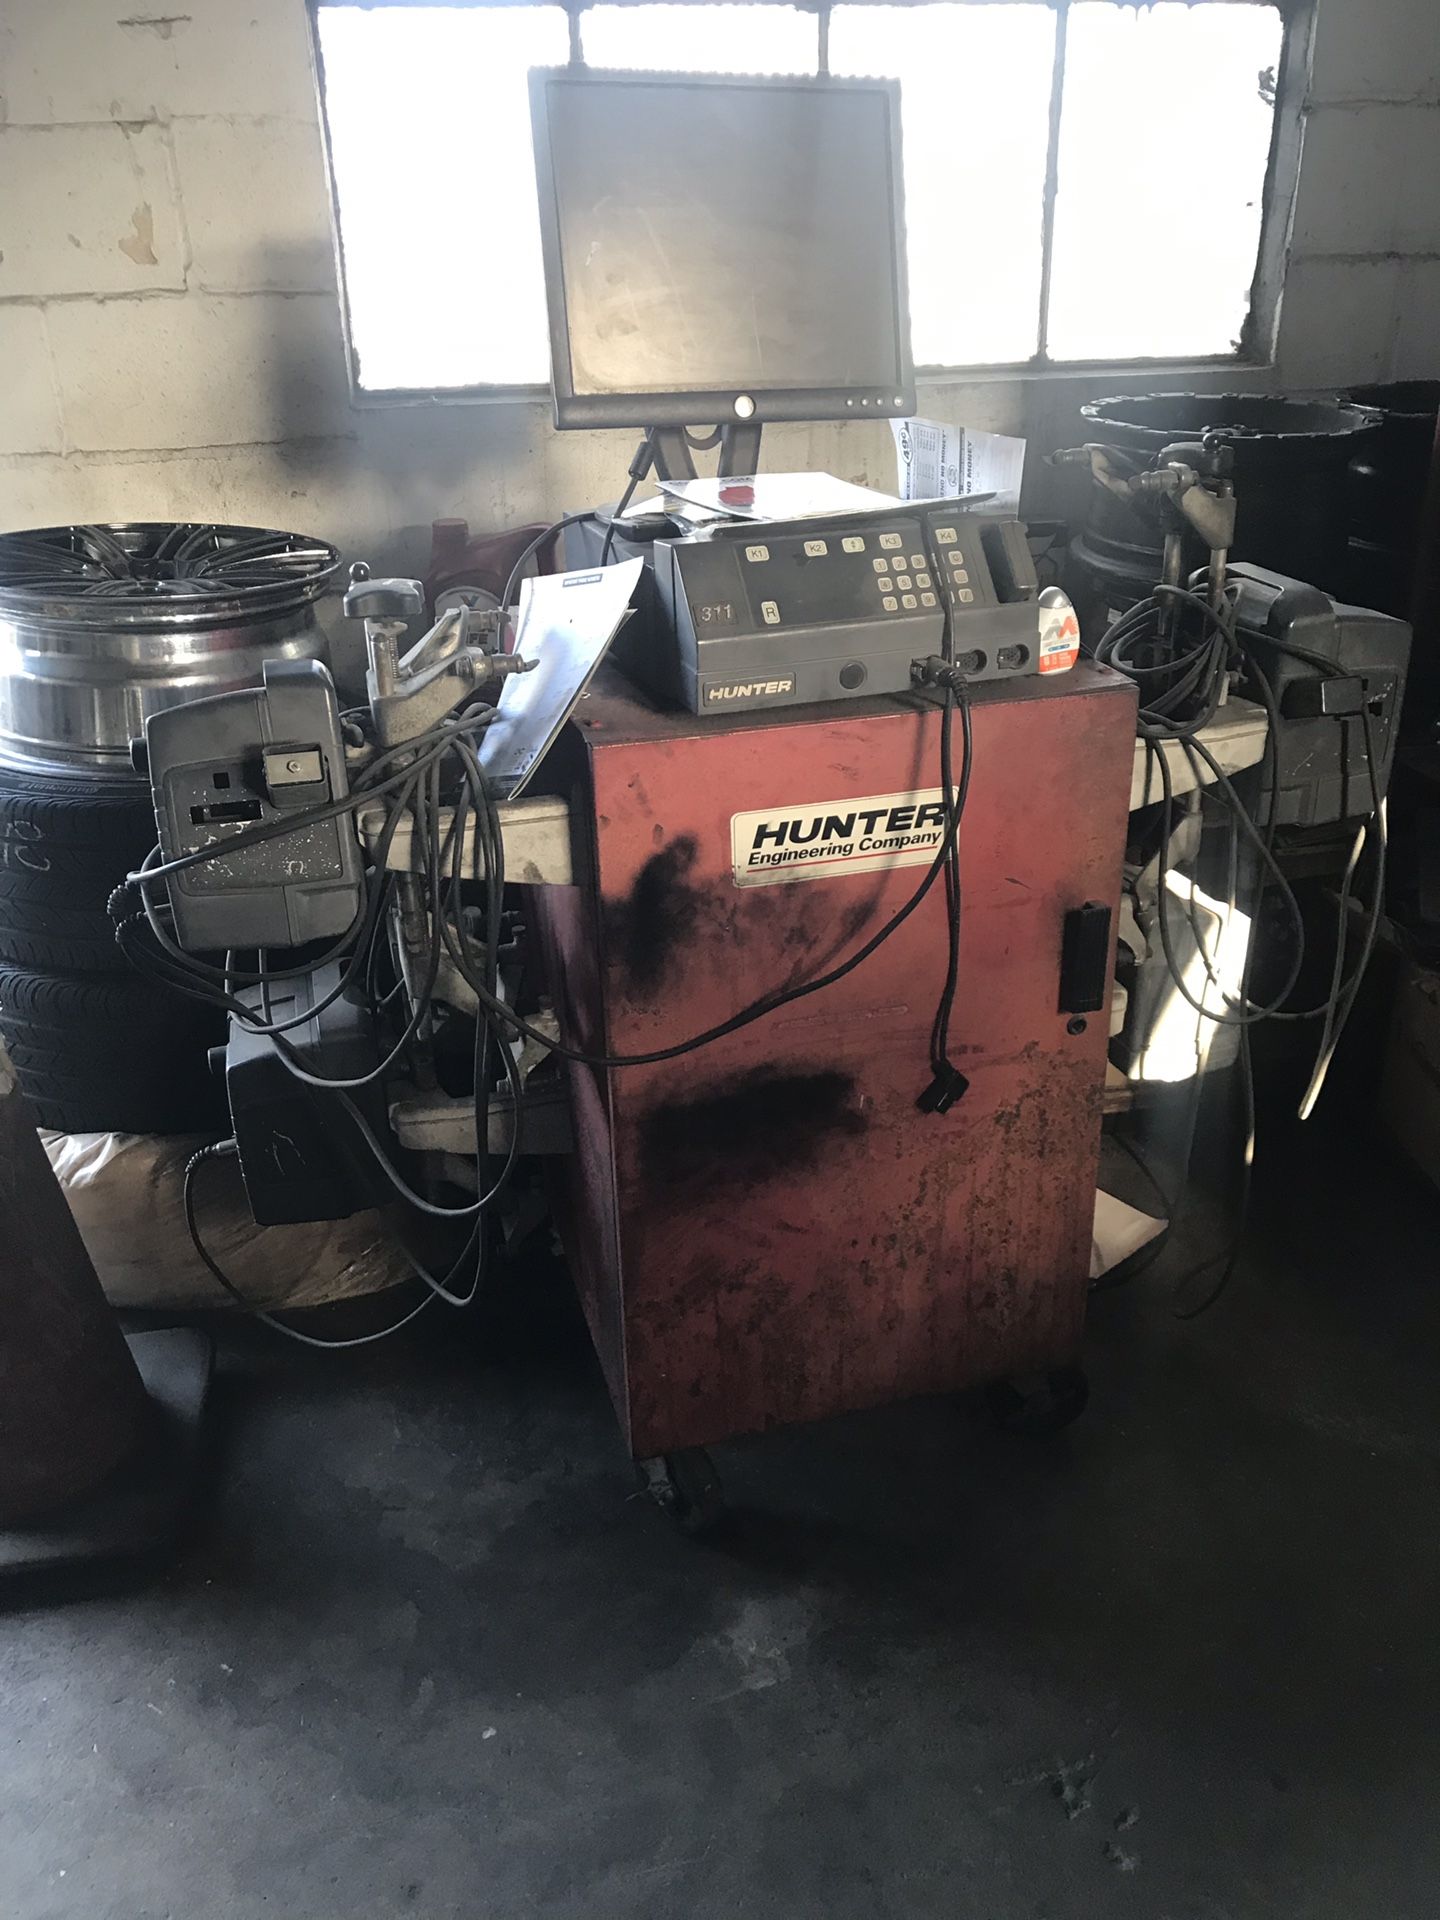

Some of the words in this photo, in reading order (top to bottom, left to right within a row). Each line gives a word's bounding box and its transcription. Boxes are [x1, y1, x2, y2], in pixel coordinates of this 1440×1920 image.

[752, 549, 764, 559] K1
[810, 544, 823, 553] K2
[885, 536, 897, 545] K3
[941, 531, 952, 540] K4
[701, 603, 731, 621] 311
[766, 607, 775, 617] R
[709, 680, 792, 700] HUNTER
[752, 802, 948, 849] HUNTER
[748, 841, 854, 866] Engineering
[858, 831, 943, 852] Company
